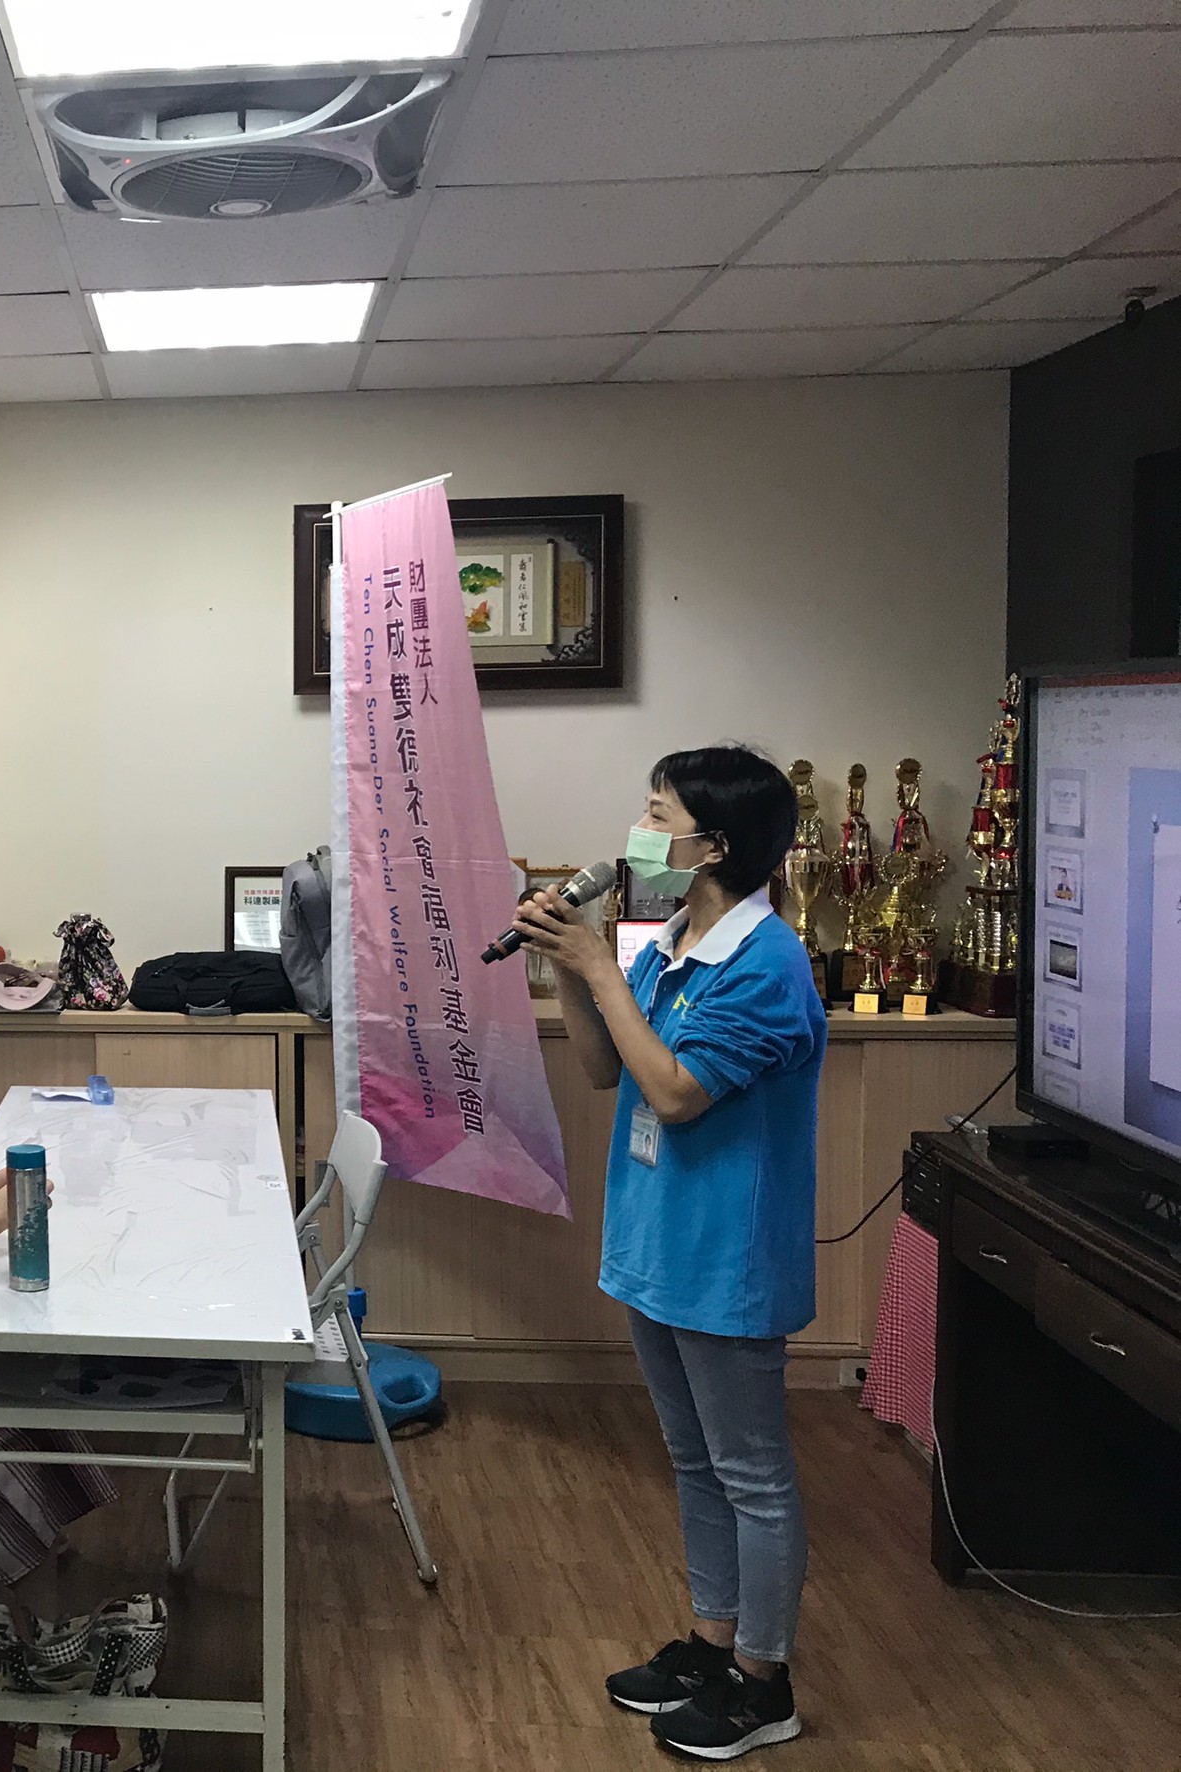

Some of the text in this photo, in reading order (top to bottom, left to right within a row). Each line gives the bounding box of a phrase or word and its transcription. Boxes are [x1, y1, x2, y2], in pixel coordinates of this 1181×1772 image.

[364, 573, 373, 615] Ten
[408, 557, 438, 706] 財團法人
[363, 626, 374, 685] Chen
[378, 827, 397, 893] Social
[389, 905, 410, 994] Welfare
[403, 1003, 435, 1120] Foundation
